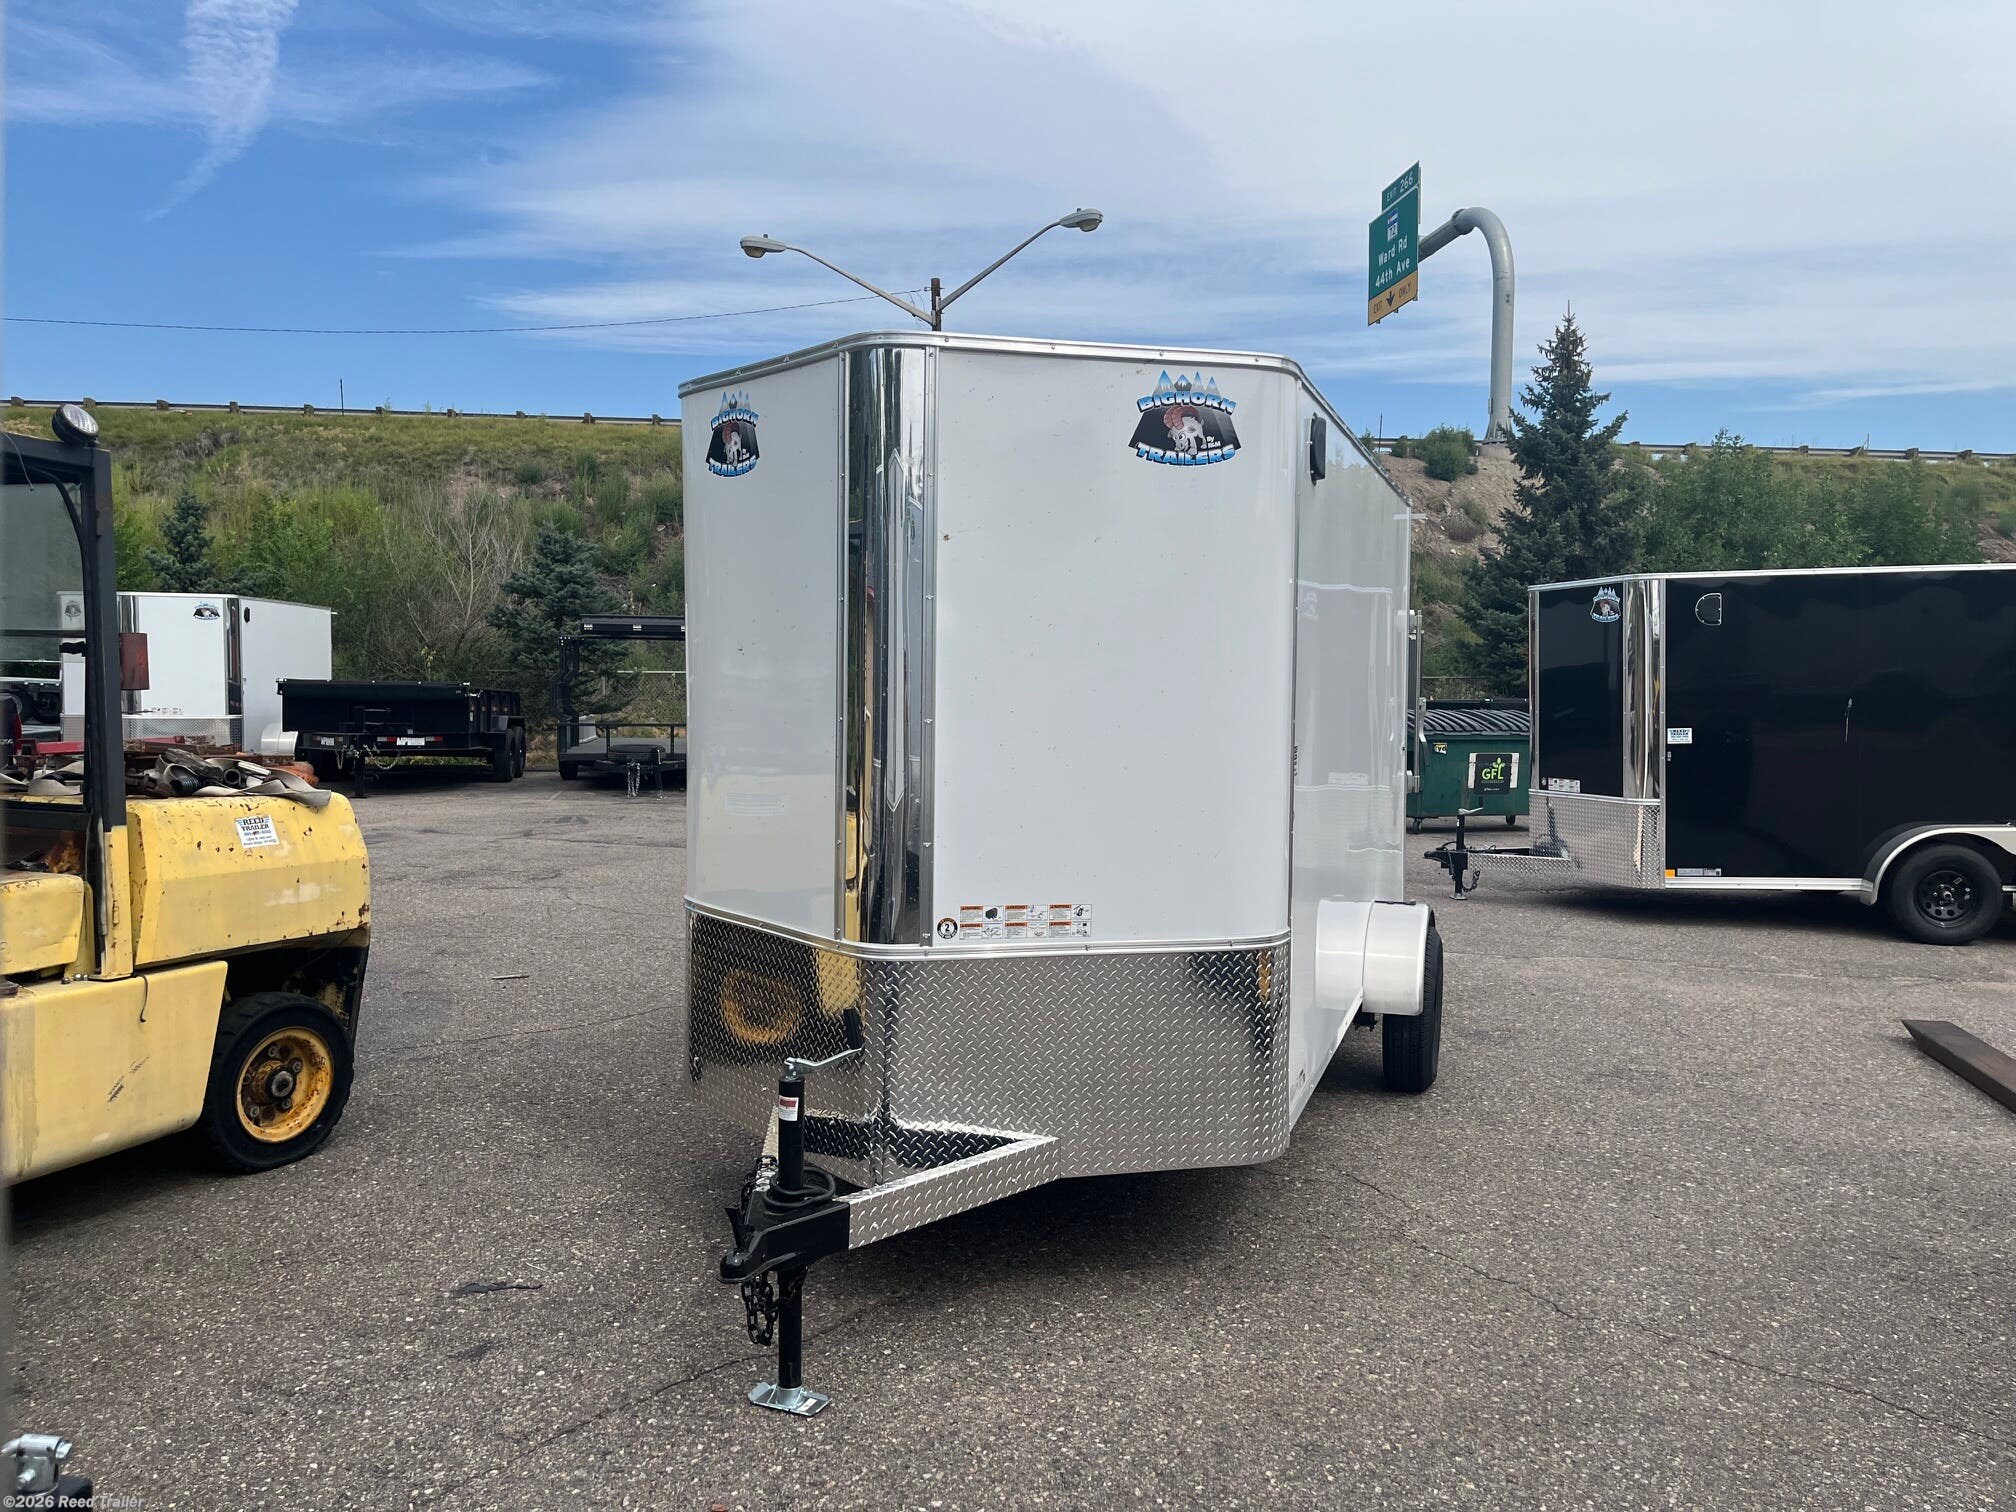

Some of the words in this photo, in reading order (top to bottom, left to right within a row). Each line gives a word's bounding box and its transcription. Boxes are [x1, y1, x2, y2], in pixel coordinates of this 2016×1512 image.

[1399, 172, 1414, 193] 266
[1378, 244, 1396, 266] Ward
[1398, 235, 1408, 251] Rd
[1375, 268, 1393, 288] 44th
[1396, 258, 1410, 275] Ave
[1399, 282, 1412, 298] ONLY
[1137, 390, 1237, 415] BIGHORN
[710, 407, 760, 431] BIGHORN
[1136, 442, 1237, 466] TRAILERS
[708, 455, 759, 477] TRAILERS
[1482, 765, 1503, 779] GFL
[241, 824, 270, 832] TRAILER
[944, 923, 950, 932] 2
